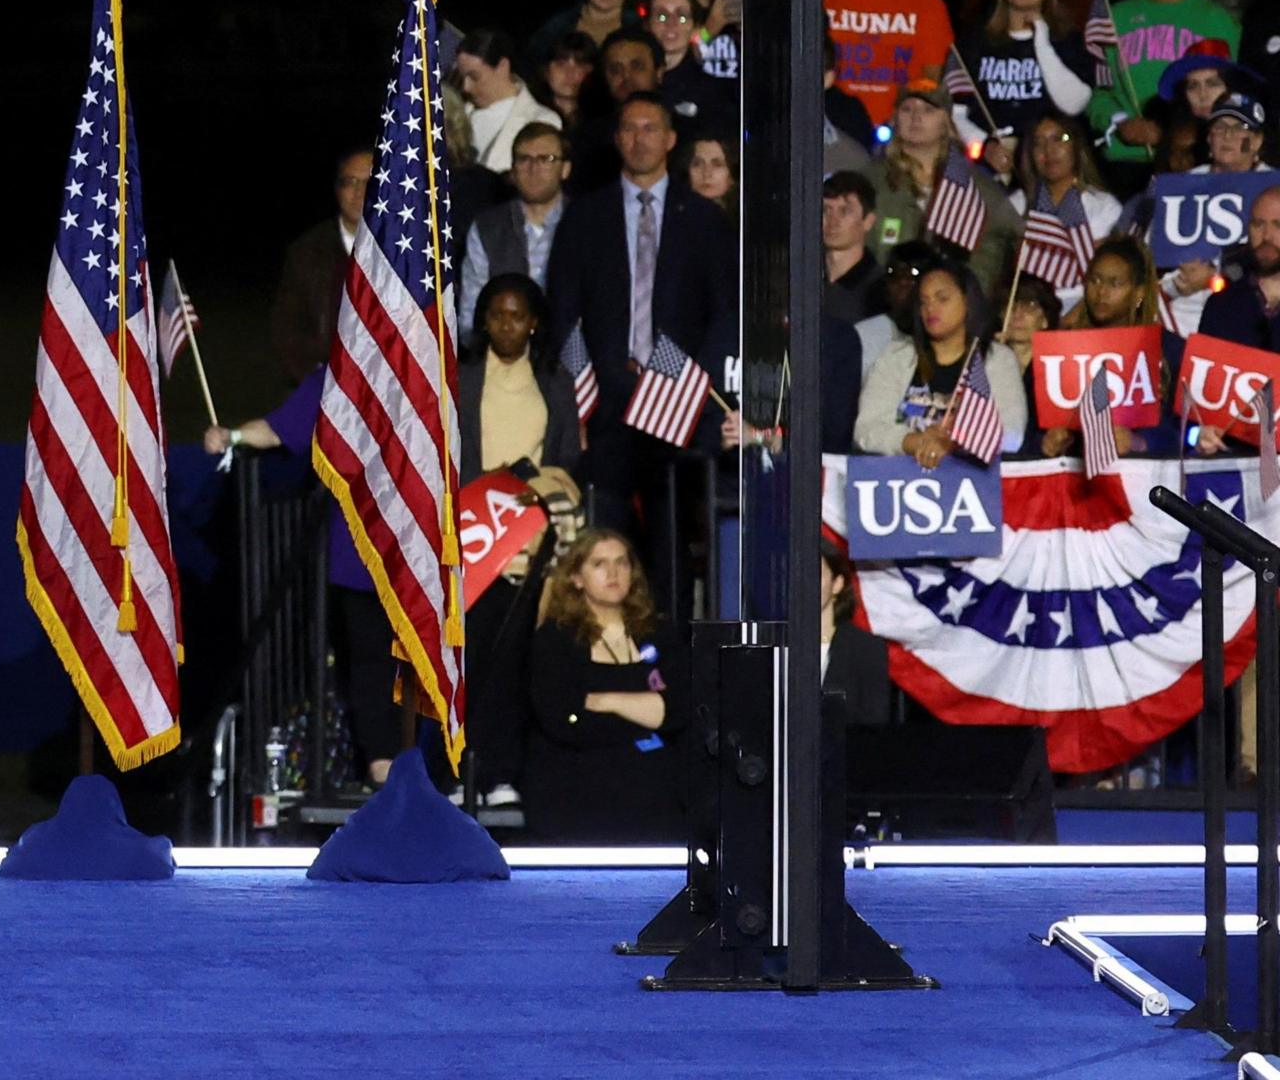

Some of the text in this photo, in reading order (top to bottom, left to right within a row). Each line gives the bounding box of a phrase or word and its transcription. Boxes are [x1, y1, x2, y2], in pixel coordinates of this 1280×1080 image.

[703, 60, 739, 78] ALZ
[979, 56, 1041, 81] HARRI
[988, 80, 1043, 99] WALZ
[1162, 192, 1248, 247] US
[1040, 351, 1157, 409] USA
[1190, 355, 1280, 424] US
[460, 488, 527, 572] SA
[853, 477, 997, 536] USA
